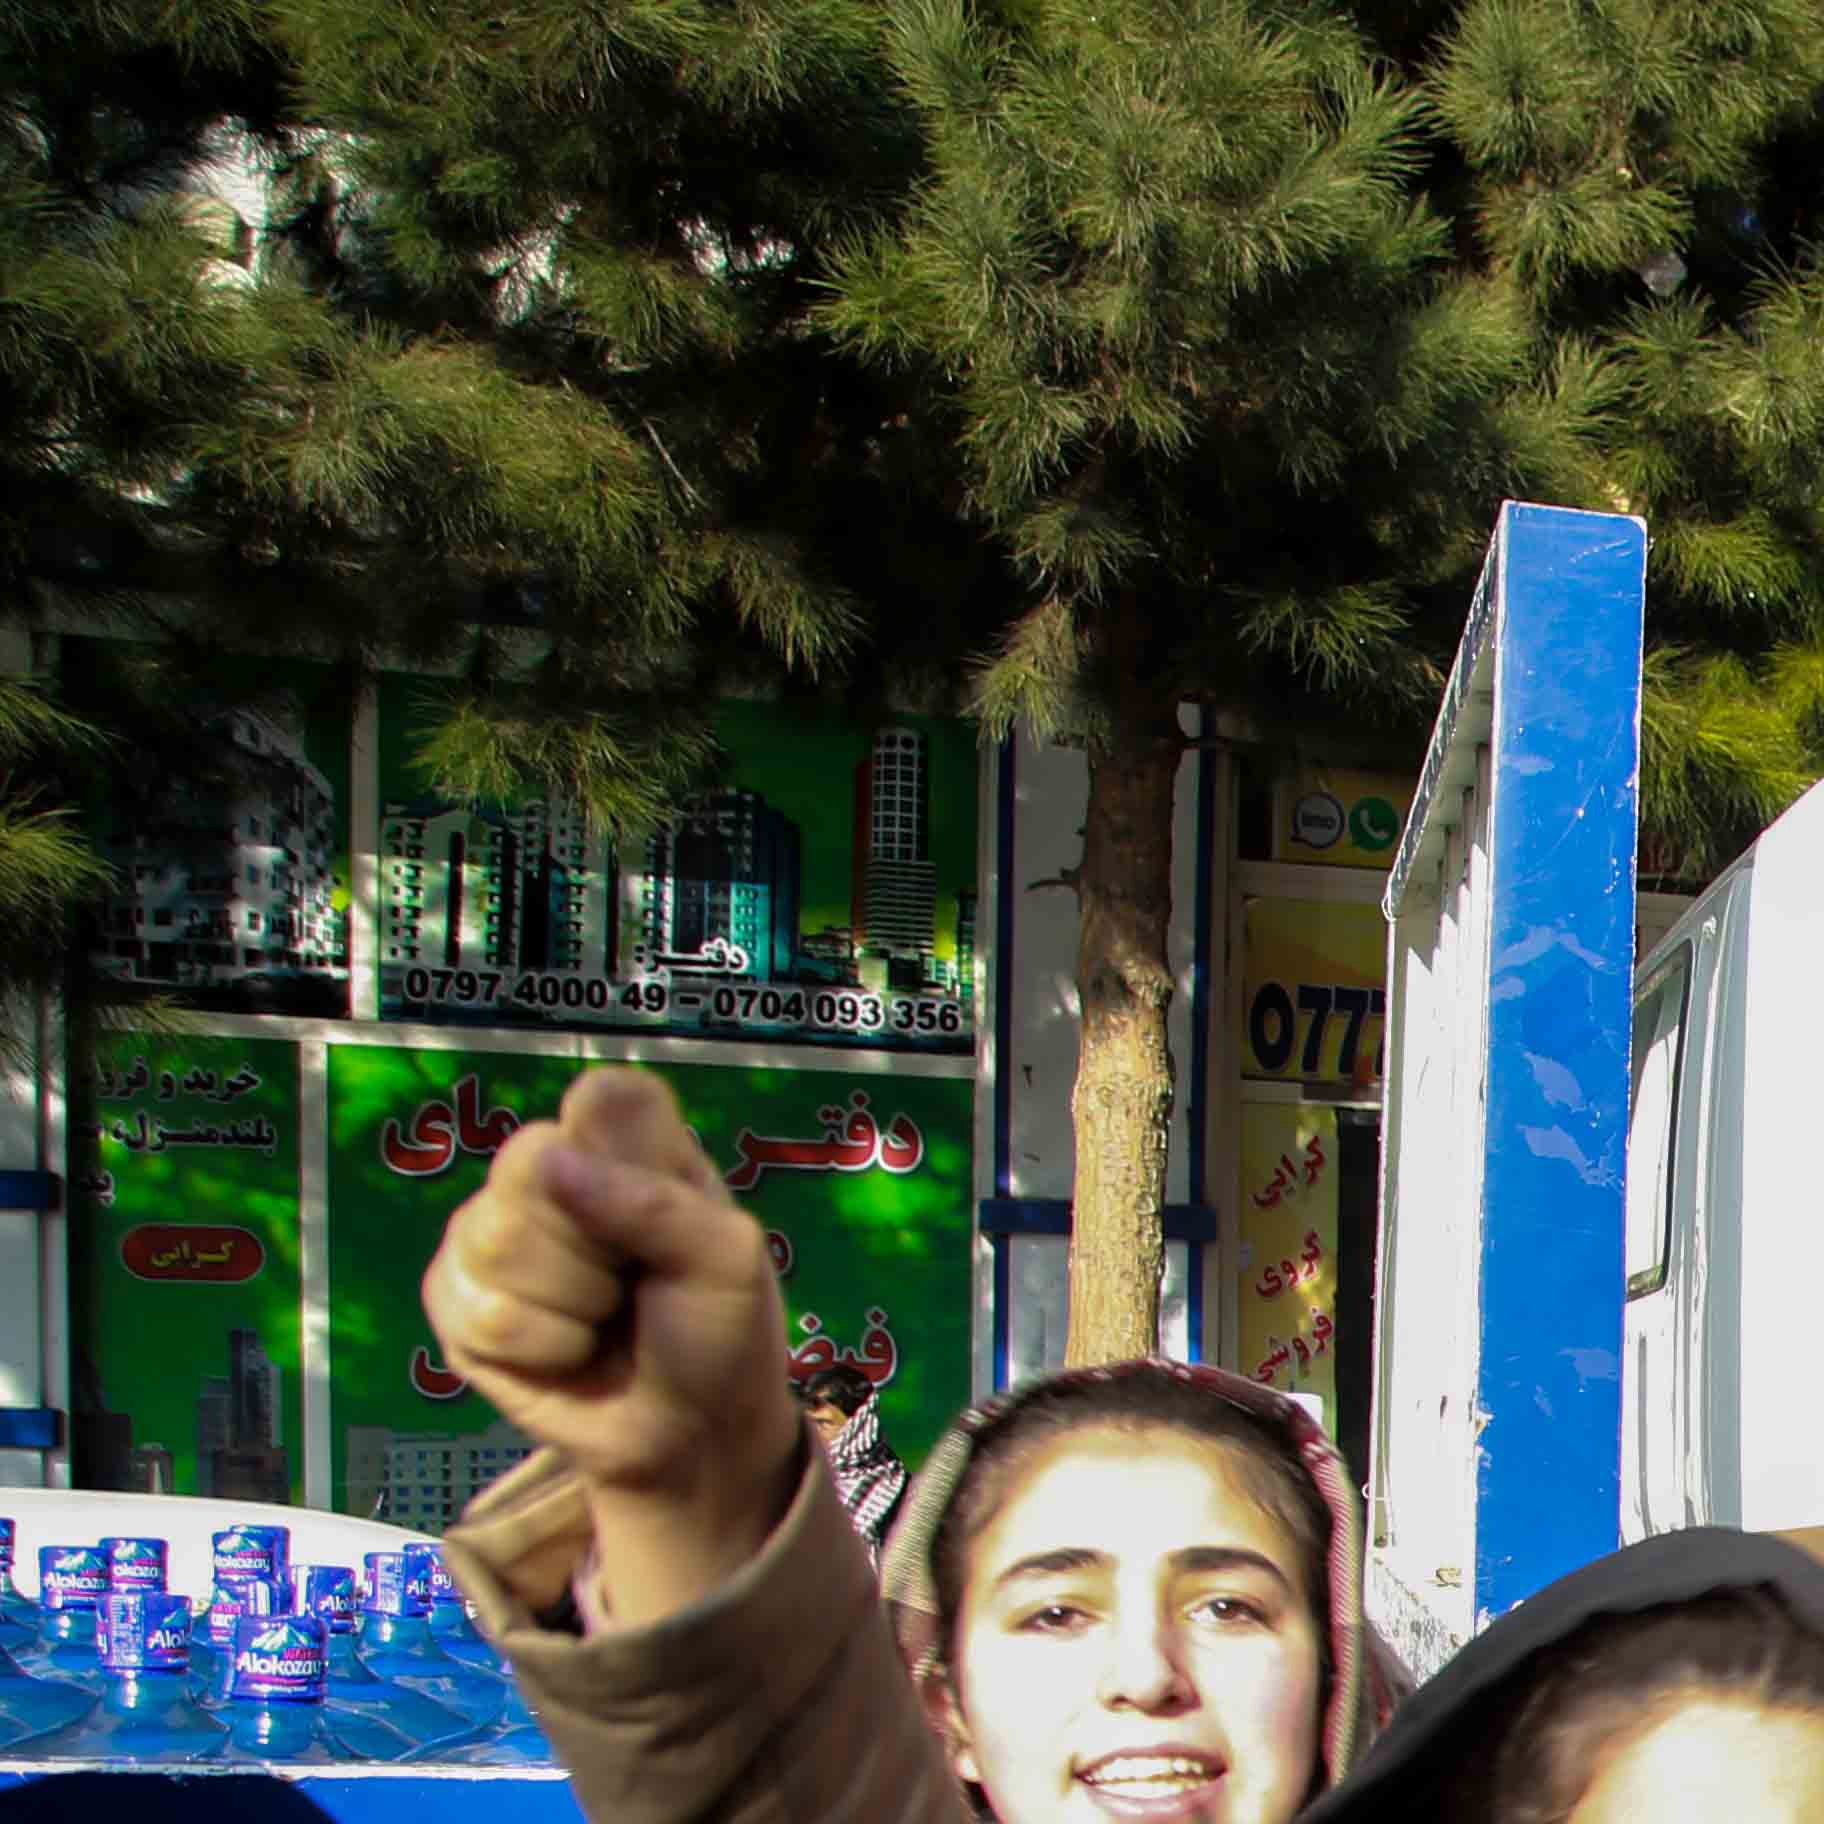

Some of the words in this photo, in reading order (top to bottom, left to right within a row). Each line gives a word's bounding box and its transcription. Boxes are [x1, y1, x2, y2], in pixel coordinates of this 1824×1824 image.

[404, 967, 501, 1002] 0797
[514, 974, 608, 1010] 4000
[621, 976, 668, 1013] 49
[713, 986, 805, 1023] 0704
[815, 990, 882, 1031] 093
[893, 998, 961, 1033] 356
[724, 1090, 923, 1190] دفتر
